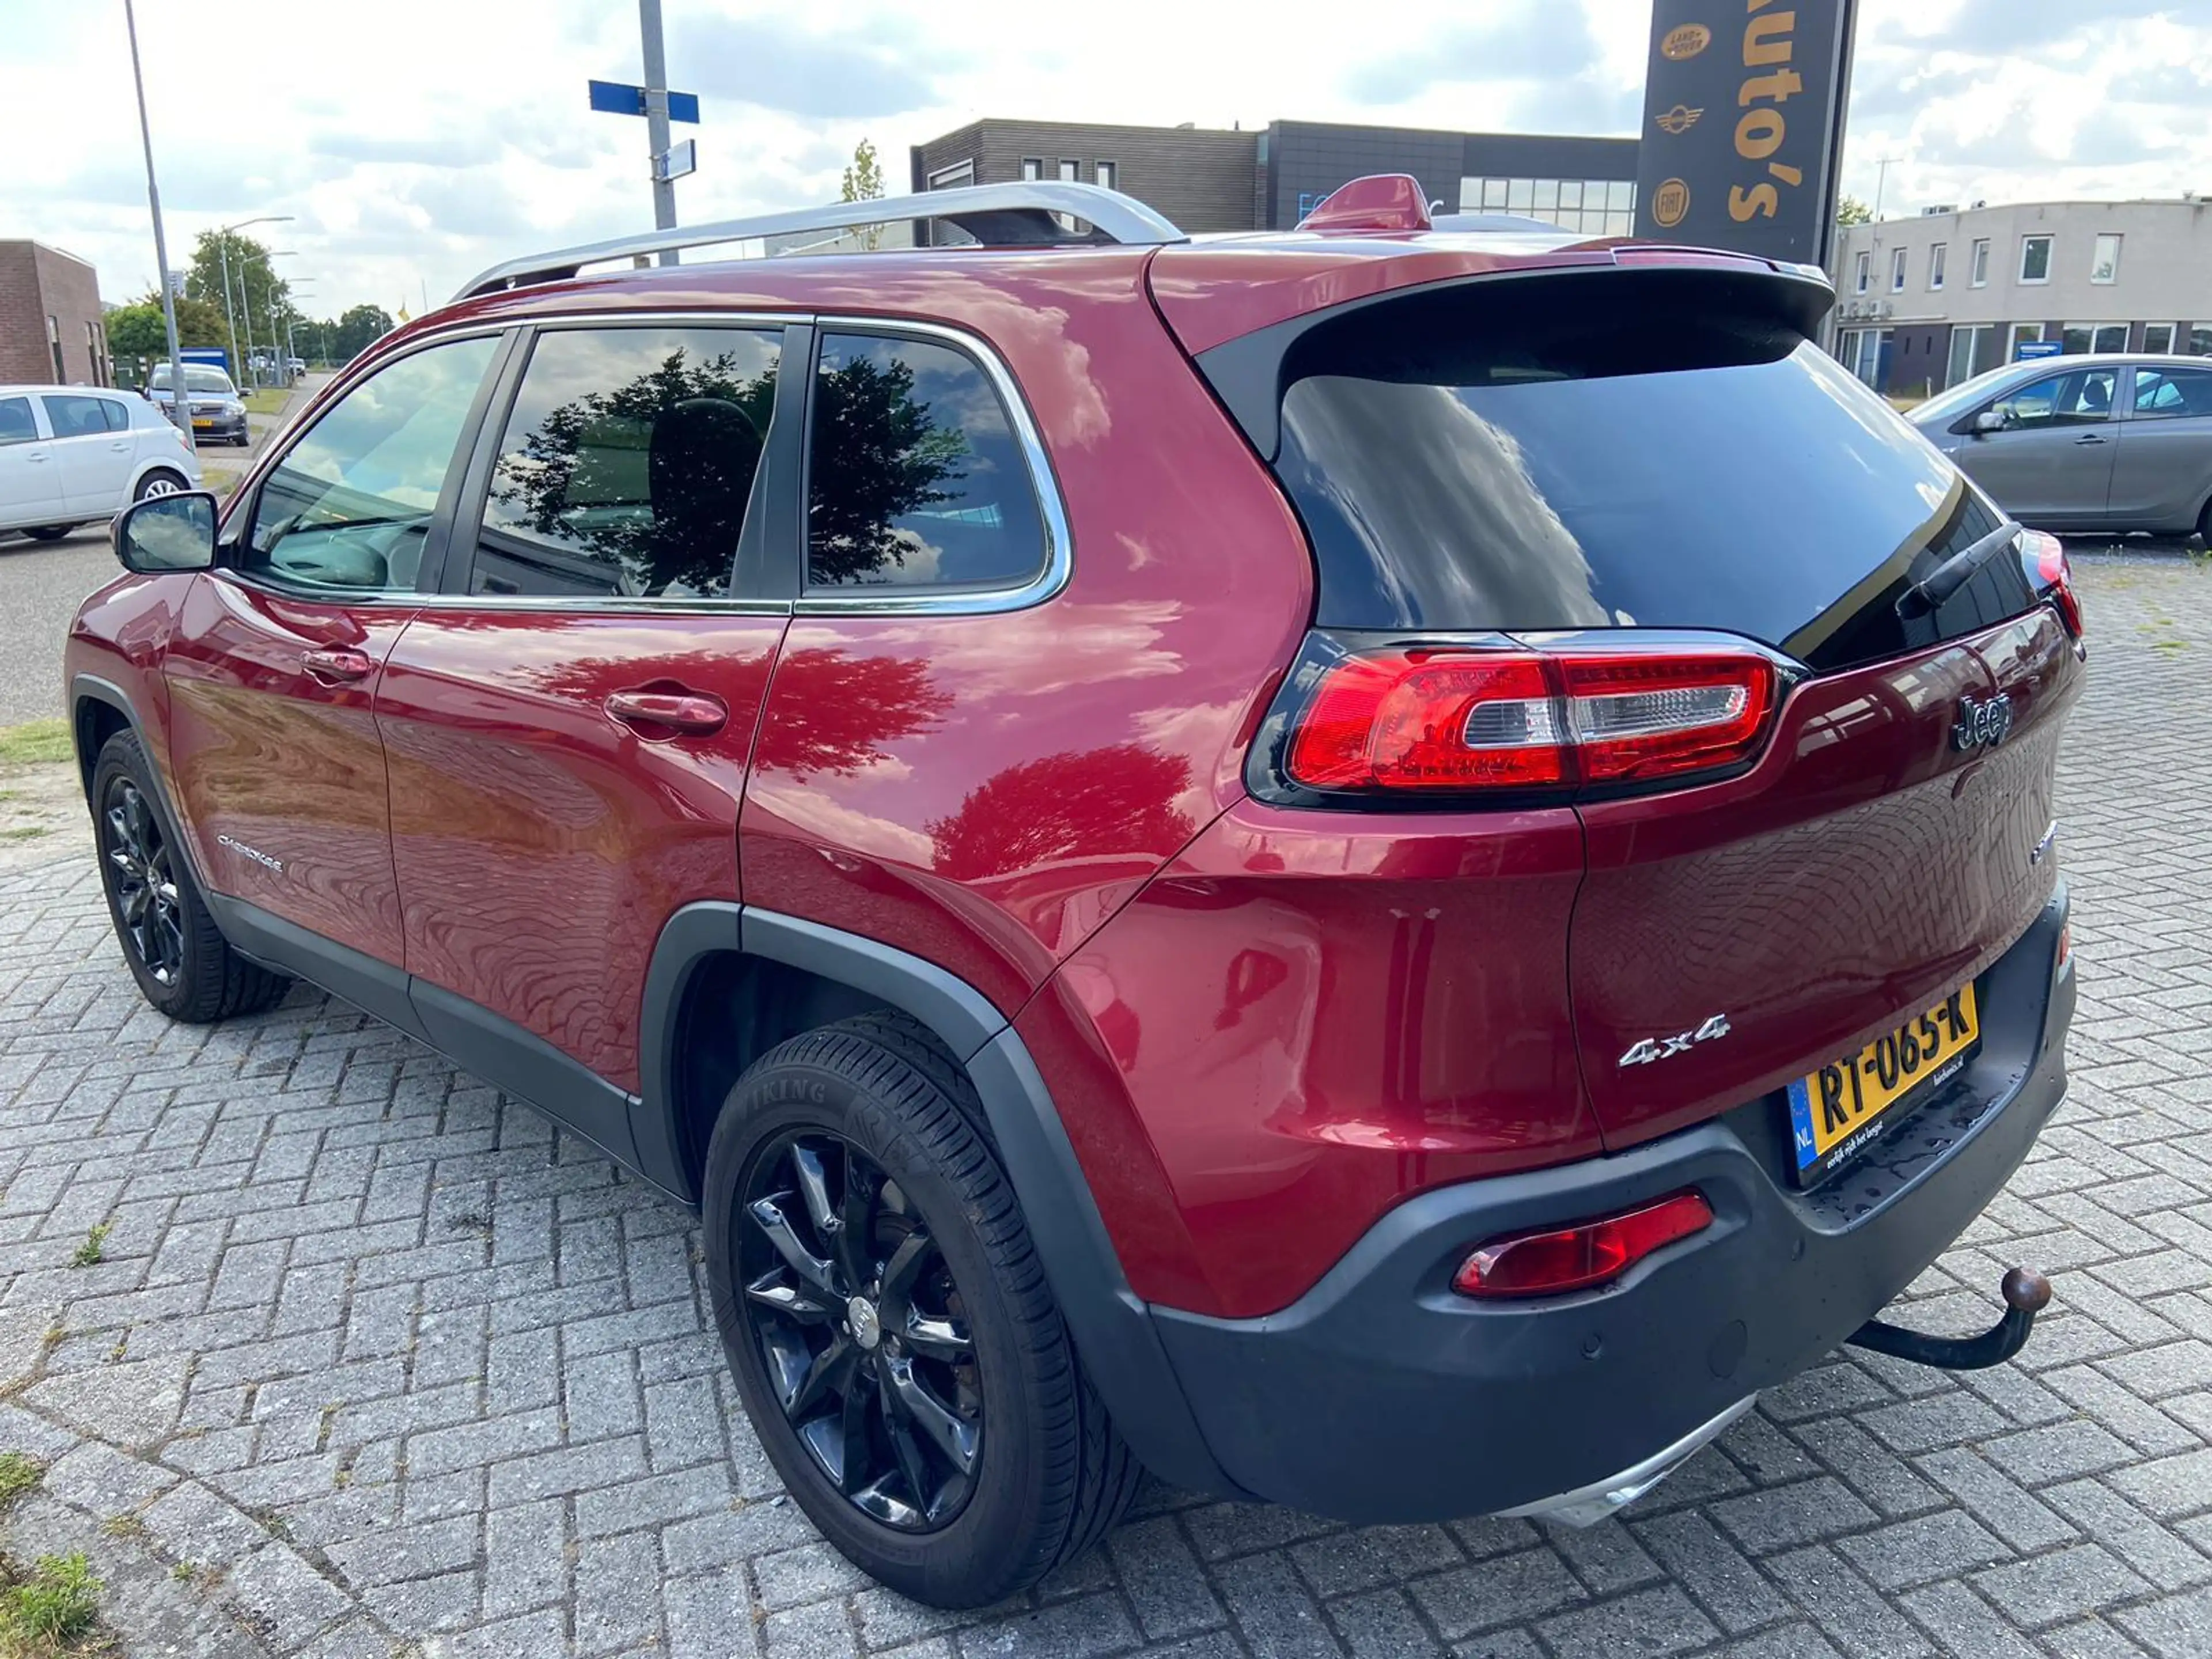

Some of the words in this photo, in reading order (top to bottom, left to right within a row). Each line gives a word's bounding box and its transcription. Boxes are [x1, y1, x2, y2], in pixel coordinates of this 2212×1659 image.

[1729, 0, 1802, 222] uto's
[1660, 191, 1681, 215] FIAT
[1953, 692, 2010, 749] Jeep
[1619, 1013, 1731, 1067] 4x4
[1818, 991, 1969, 1135] RT-065-K
[1796, 1127, 1812, 1150] NL
